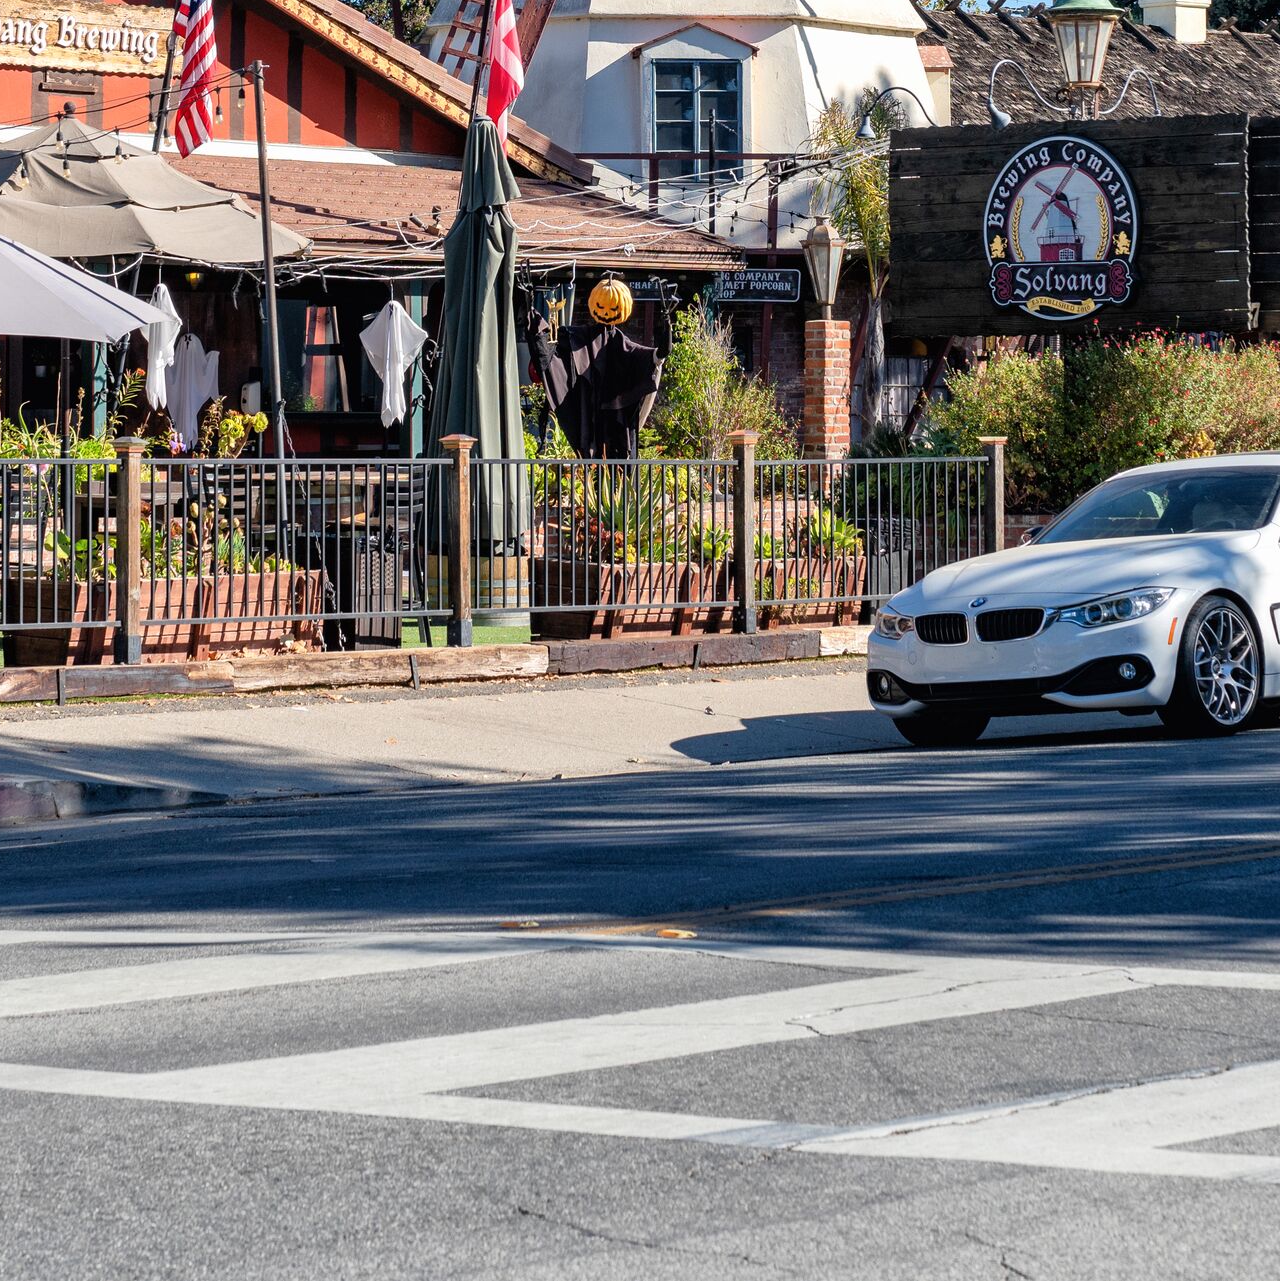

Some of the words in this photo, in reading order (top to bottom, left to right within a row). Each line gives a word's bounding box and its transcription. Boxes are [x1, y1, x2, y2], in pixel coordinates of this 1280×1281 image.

[56, 14, 160, 64] Brewing
[988, 146, 1051, 229] Brewing
[1061, 142, 1131, 225] Company
[734, 272, 781, 281] COMPANY
[749, 282, 792, 291] POPCORN
[1014, 266, 1107, 298] Solvang
[1031, 298, 1075, 312] ESTABLISHED
